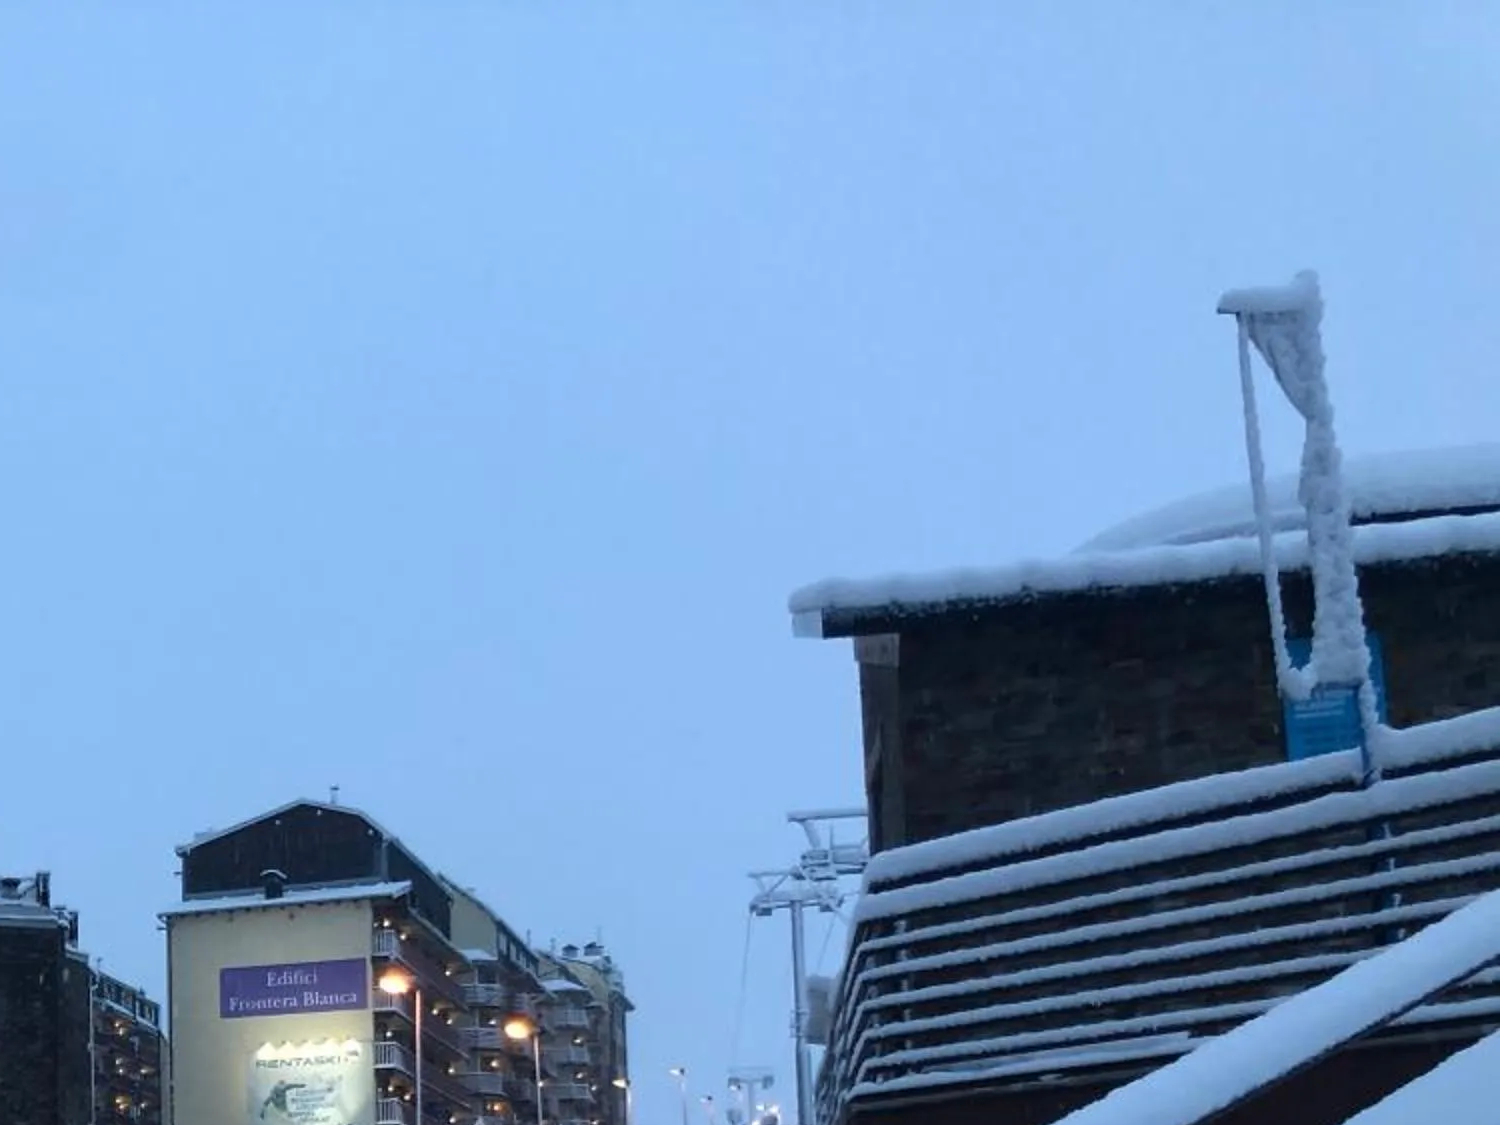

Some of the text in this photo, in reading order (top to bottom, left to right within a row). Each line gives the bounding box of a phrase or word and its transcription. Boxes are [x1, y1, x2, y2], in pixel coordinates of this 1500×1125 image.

[267, 967, 318, 987] Edifici
[229, 991, 358, 1012] Frontera Blanca
[255, 1055, 341, 1069] RENTASKI
